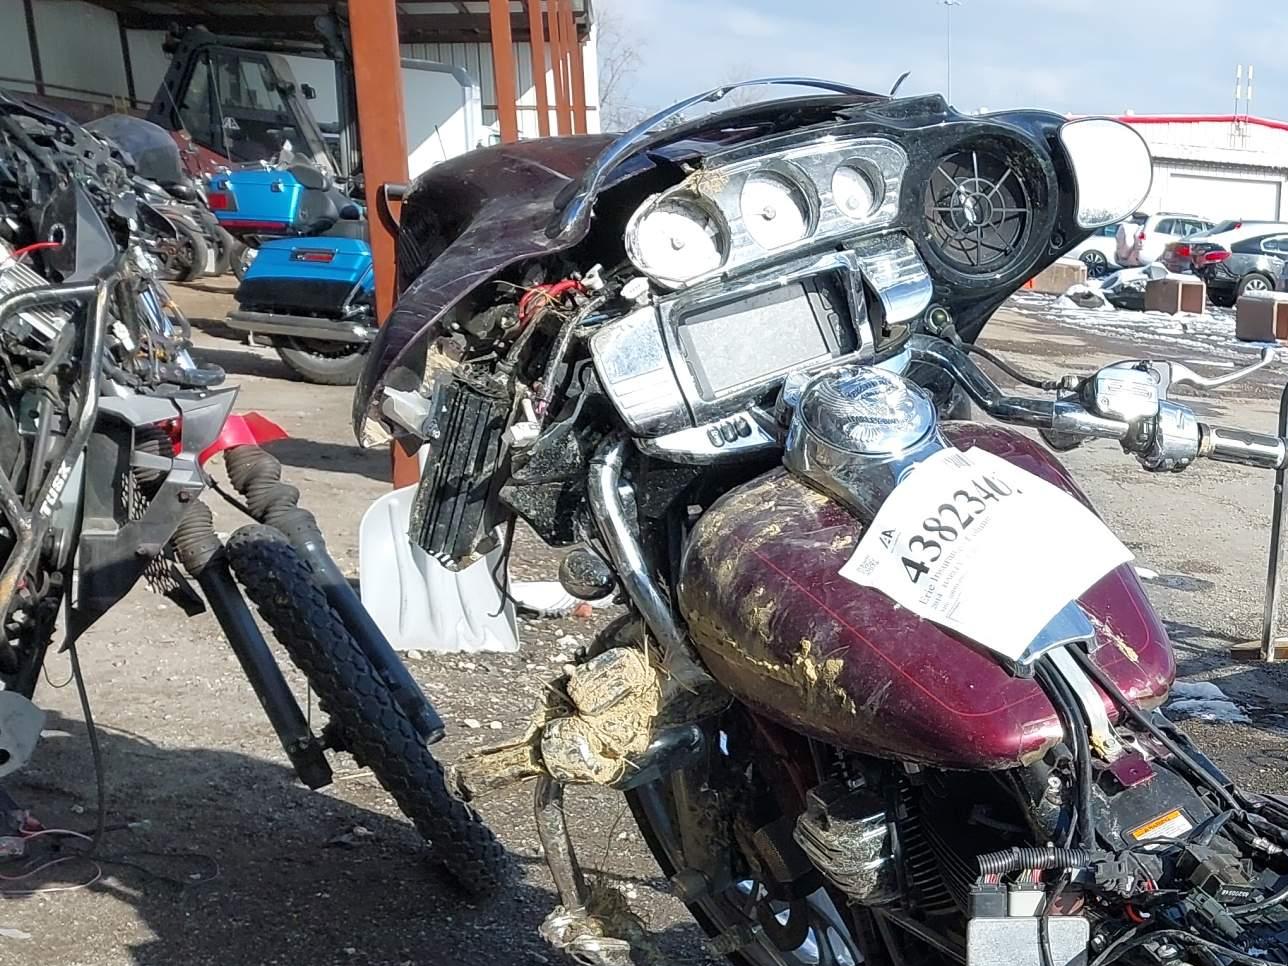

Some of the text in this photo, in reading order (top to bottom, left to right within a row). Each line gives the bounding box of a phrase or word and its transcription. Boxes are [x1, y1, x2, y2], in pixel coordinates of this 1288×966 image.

[39, 459, 72, 516] TUSK
[901, 473, 1023, 583] 4382340
[918, 584, 936, 605] Erie
